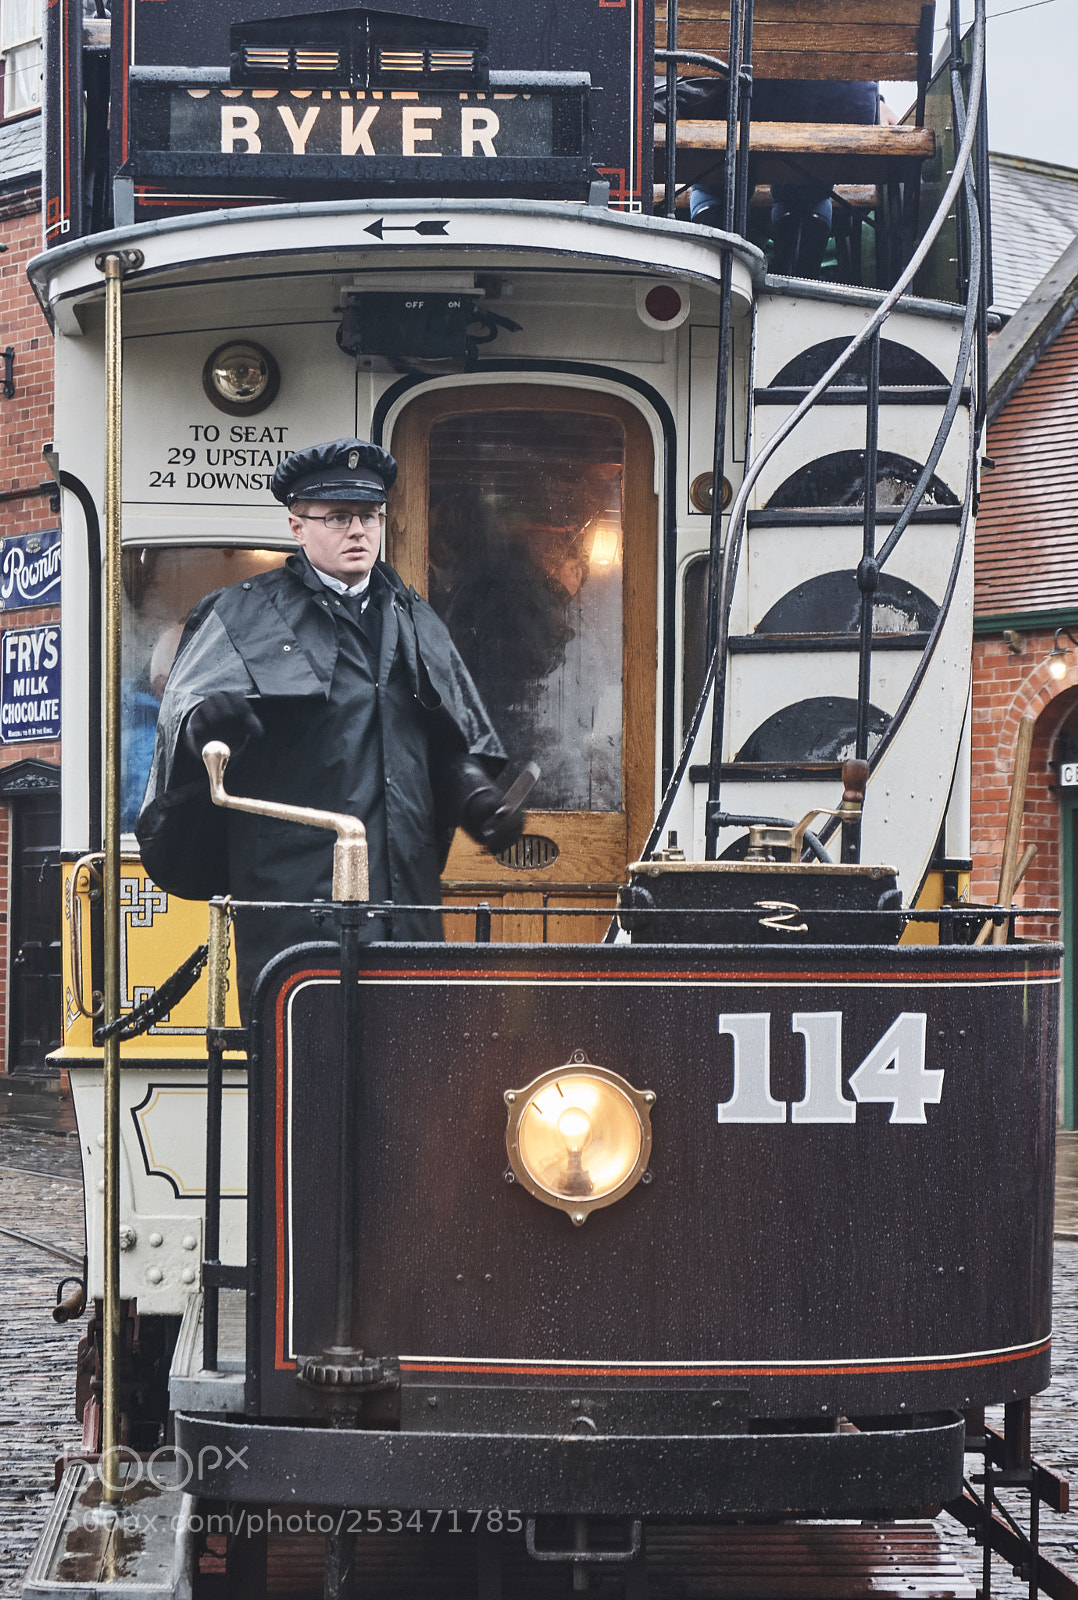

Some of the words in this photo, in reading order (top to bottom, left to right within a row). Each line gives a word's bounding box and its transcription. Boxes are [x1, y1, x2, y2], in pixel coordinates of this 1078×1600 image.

[221, 106, 500, 157] BYKER
[447, 301, 461, 309] ON
[190, 425, 220, 442] TO
[230, 426, 288, 443] SEAT
[168, 448, 196, 466] 29
[149, 471, 176, 488] 24
[5, 629, 59, 674] FRY'S
[13, 676, 48, 697] MILK
[3, 699, 59, 725] CHOCOLATE
[718, 1011, 944, 1124] 114
